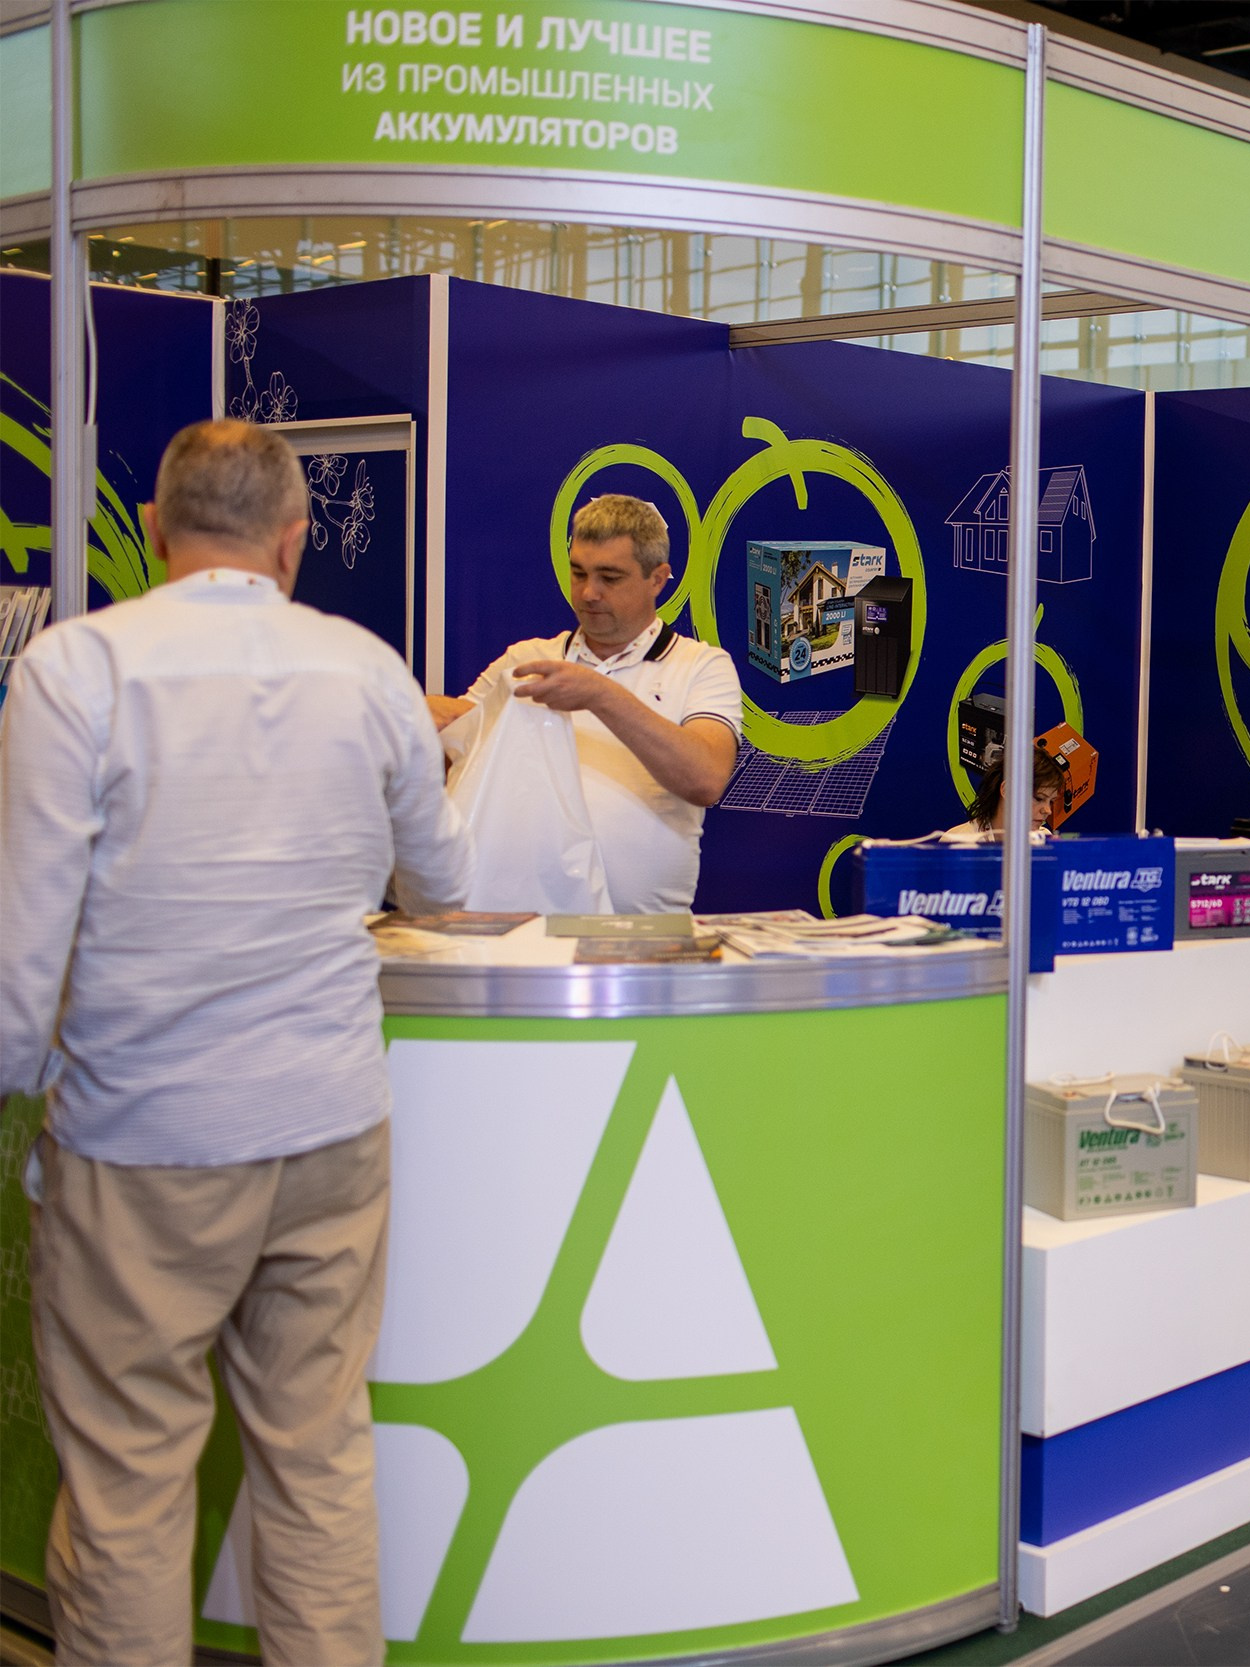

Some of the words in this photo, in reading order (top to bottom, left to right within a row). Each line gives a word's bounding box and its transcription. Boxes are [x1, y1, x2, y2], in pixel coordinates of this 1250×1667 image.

[346, 10, 483, 47] НОВОЕ
[496, 14, 524, 49] И
[537, 16, 713, 64] ЛУЧШЕЕ
[341, 62, 386, 93] ИЗ
[398, 62, 714, 111] ПРОМЫШЛЕННЫХ
[373, 111, 679, 155] АККУМУЛЯТОРОВ
[825, 611, 840, 620] 2000
[1062, 869, 1131, 892] Ventura
[898, 889, 988, 916] Ventura
[1079, 1127, 1141, 1149] Ventura
